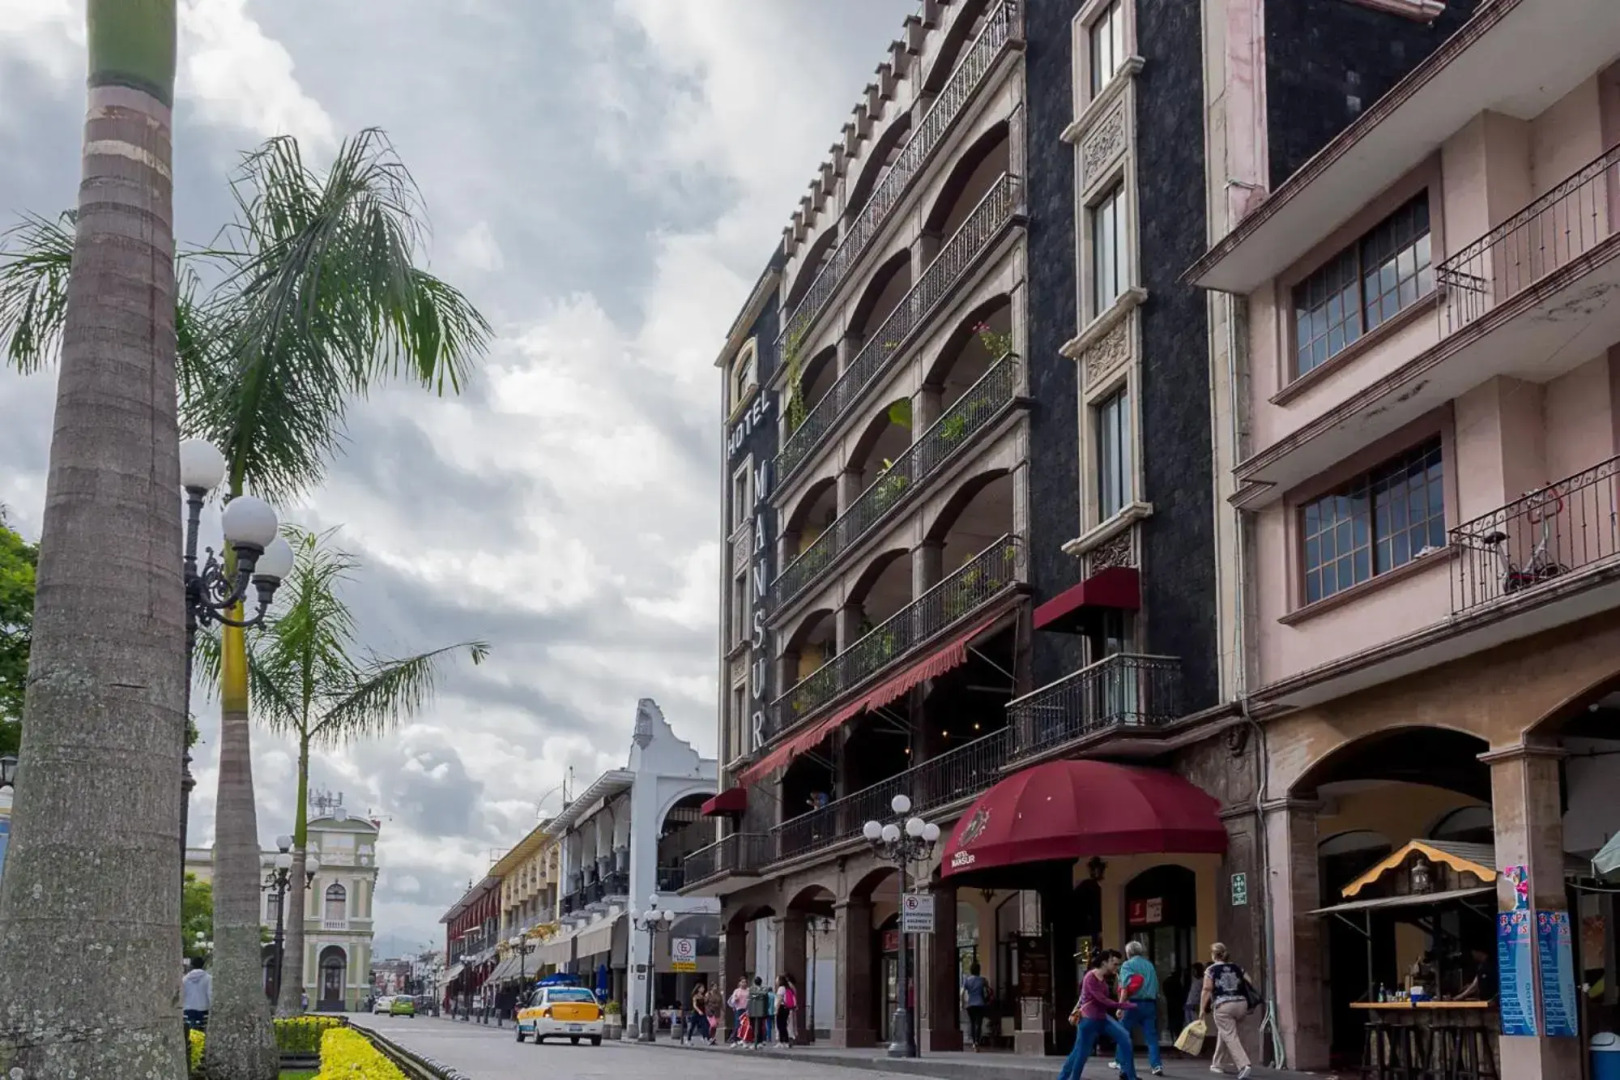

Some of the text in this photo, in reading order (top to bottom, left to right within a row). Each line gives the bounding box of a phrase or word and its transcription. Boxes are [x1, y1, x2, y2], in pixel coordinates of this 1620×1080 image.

[728, 390, 770, 460] HOTEL
[752, 459, 768, 754] MANSUR
[951, 855, 975, 868] MANSUR
[955, 850, 968, 858] HOTEL
